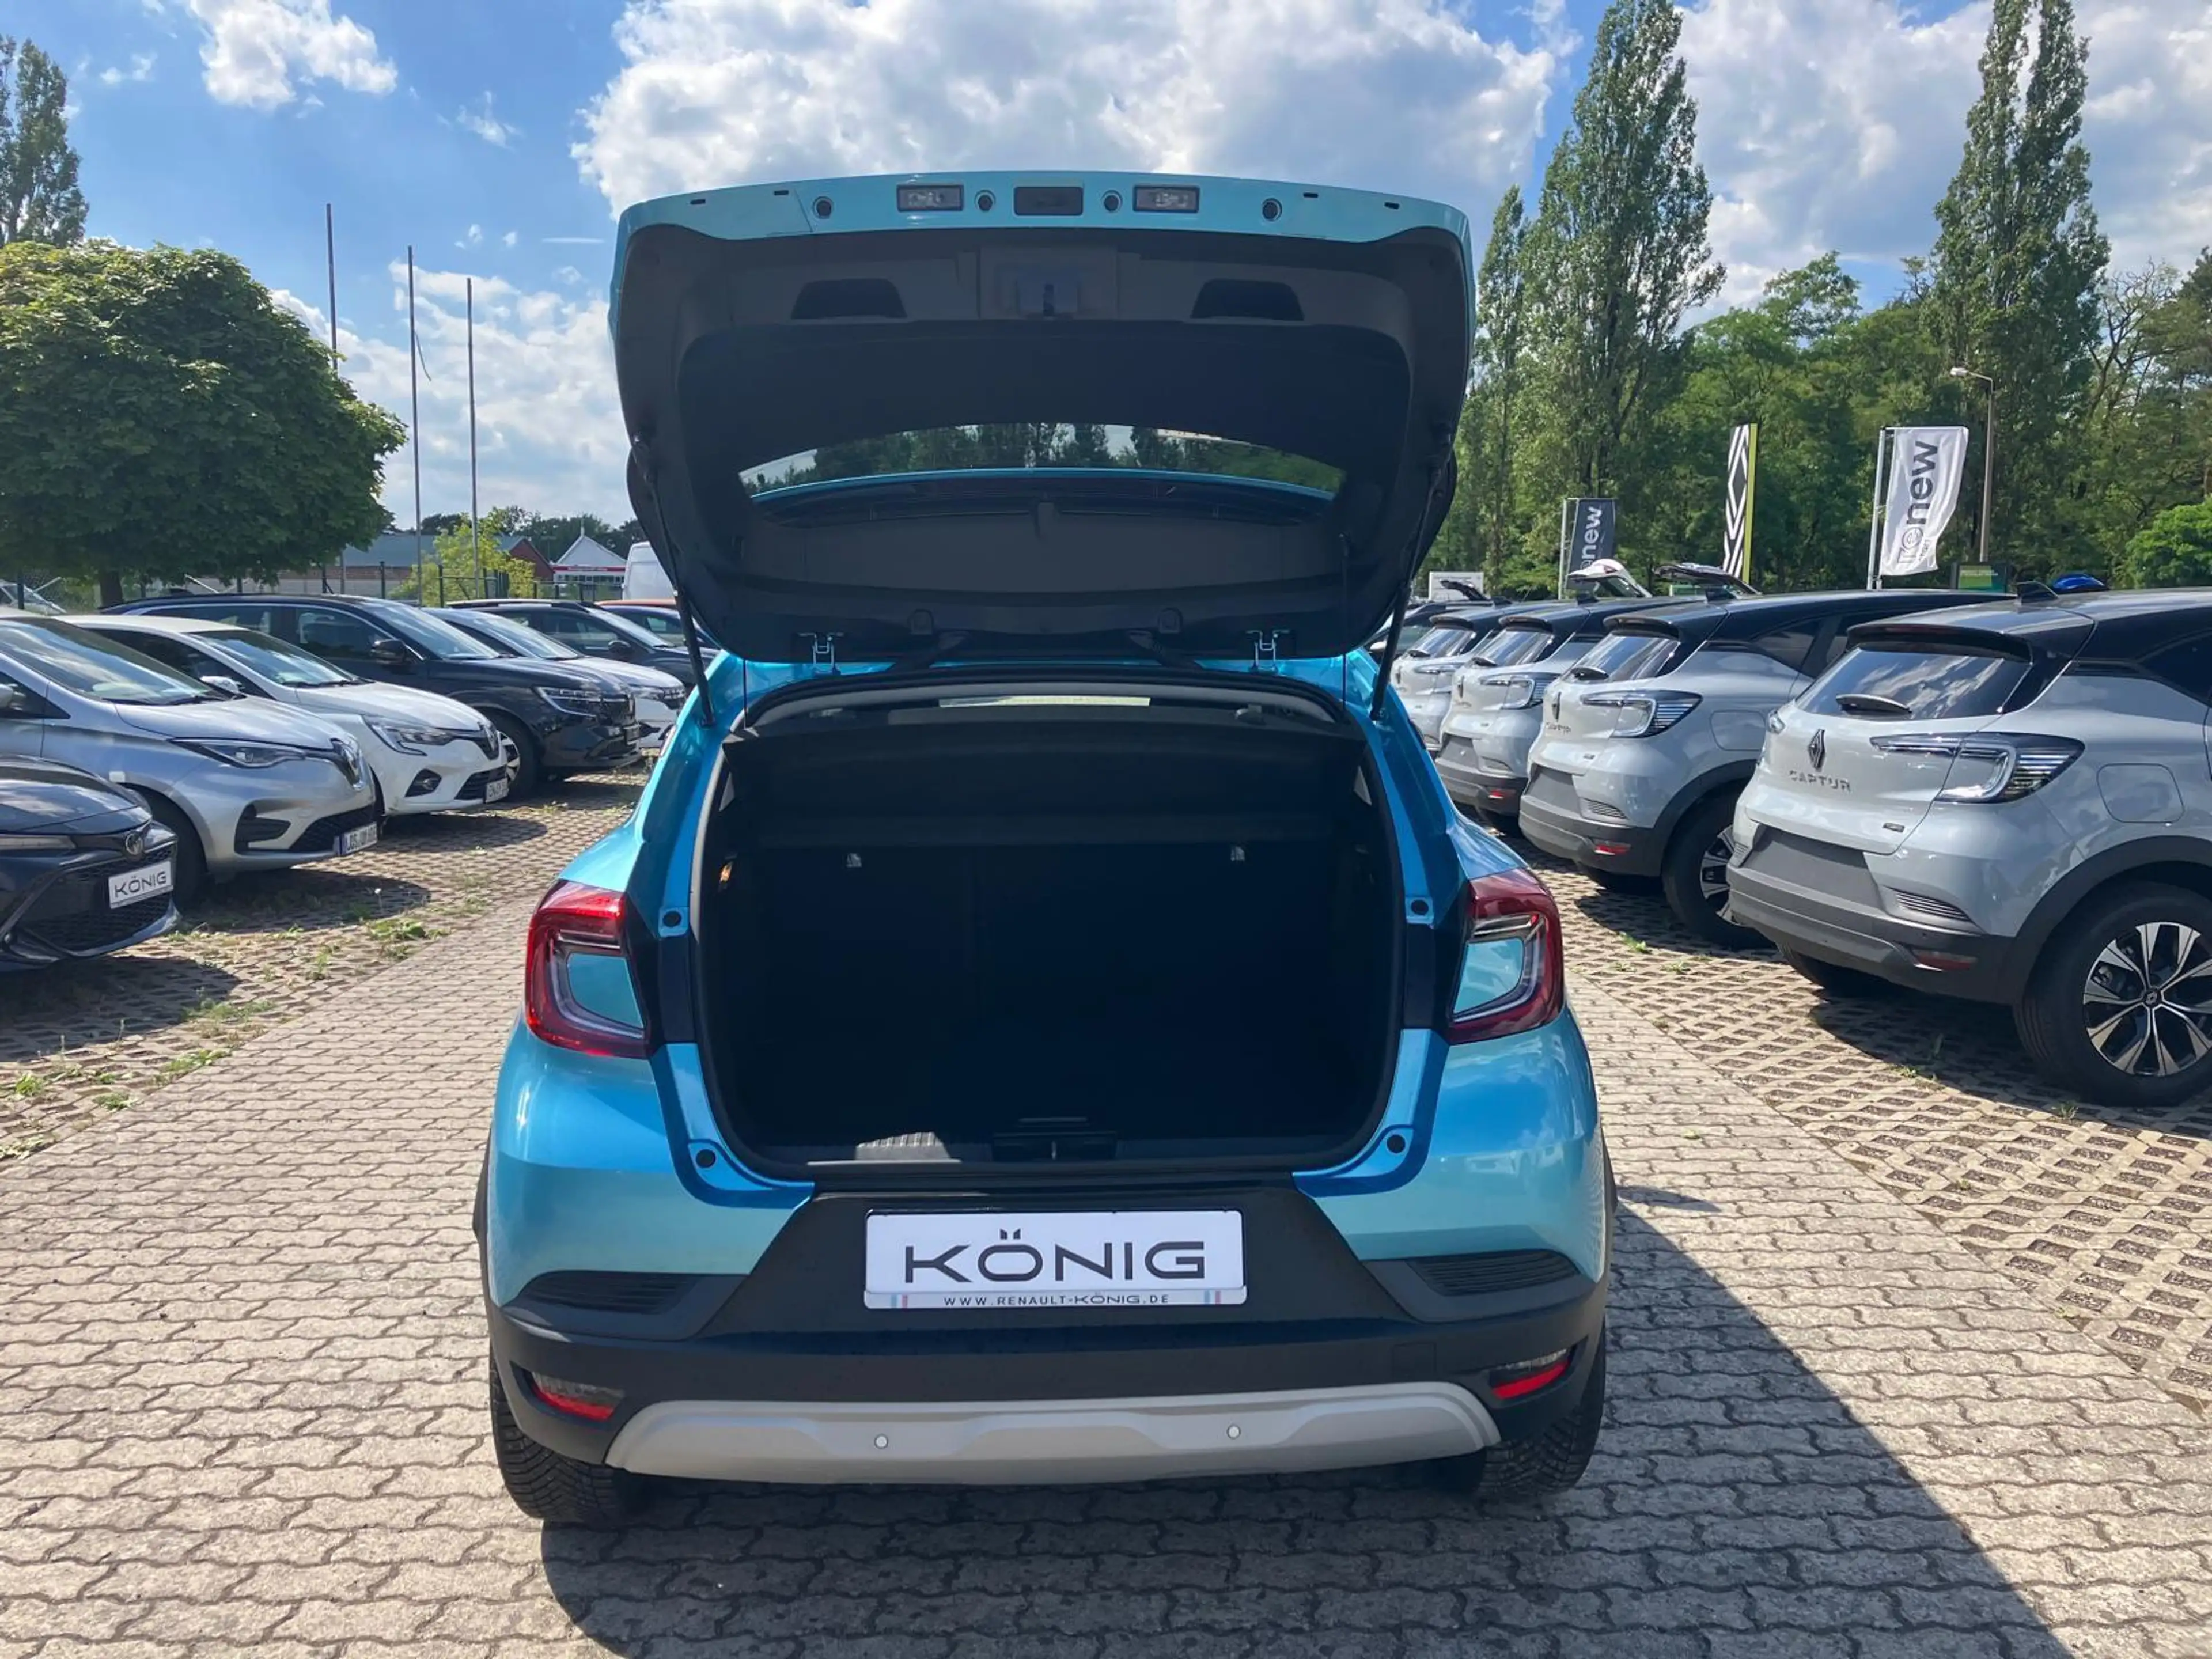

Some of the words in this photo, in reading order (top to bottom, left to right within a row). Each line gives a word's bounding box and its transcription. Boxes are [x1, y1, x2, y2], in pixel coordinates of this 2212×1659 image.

[1789, 770, 1851, 793] CAPTUR
[114, 870, 166, 898] KÖNIG
[905, 1228, 1205, 1283] KÖNIG
[944, 1292, 1169, 1306] WWW.RENAULT-KÖNIG.DE
